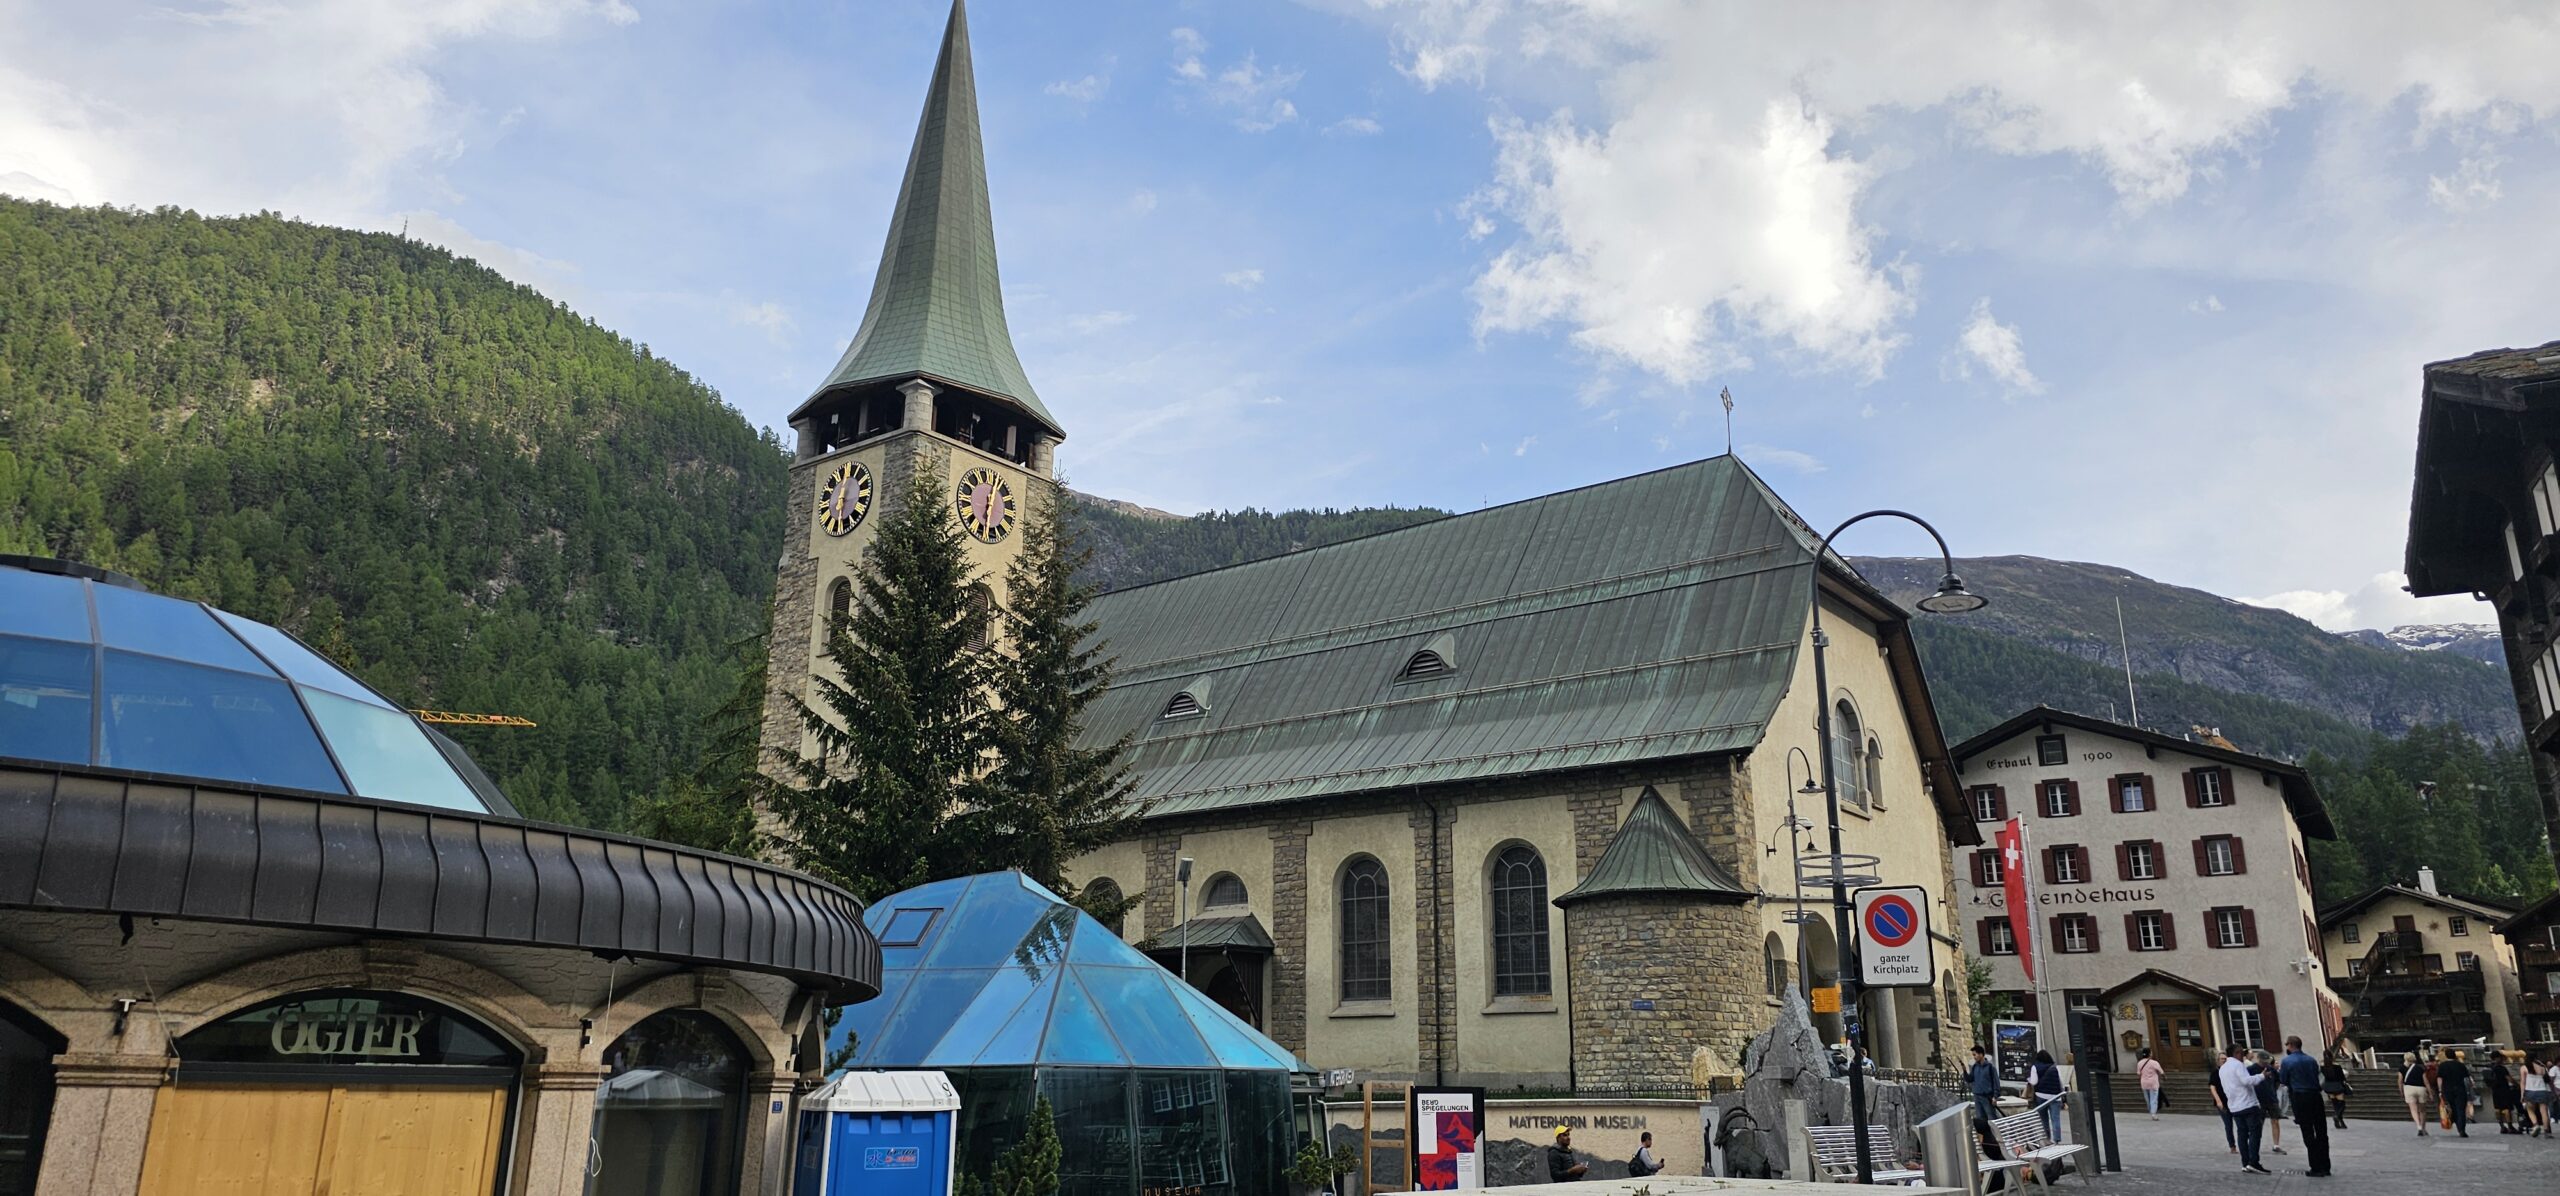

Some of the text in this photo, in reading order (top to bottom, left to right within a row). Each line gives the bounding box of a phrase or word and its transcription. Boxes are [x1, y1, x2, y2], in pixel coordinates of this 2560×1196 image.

[1986, 751, 2112, 769] Erbaut 1900
[1990, 888, 2155, 907] Geindehaus
[1880, 955, 1910, 964] ganzer
[1873, 965, 1919, 975] Kirchplatz
[1509, 1116, 1647, 1129] MATTERHORN MUSEUM
[1144, 1187, 1201, 1196] MUSEUM
